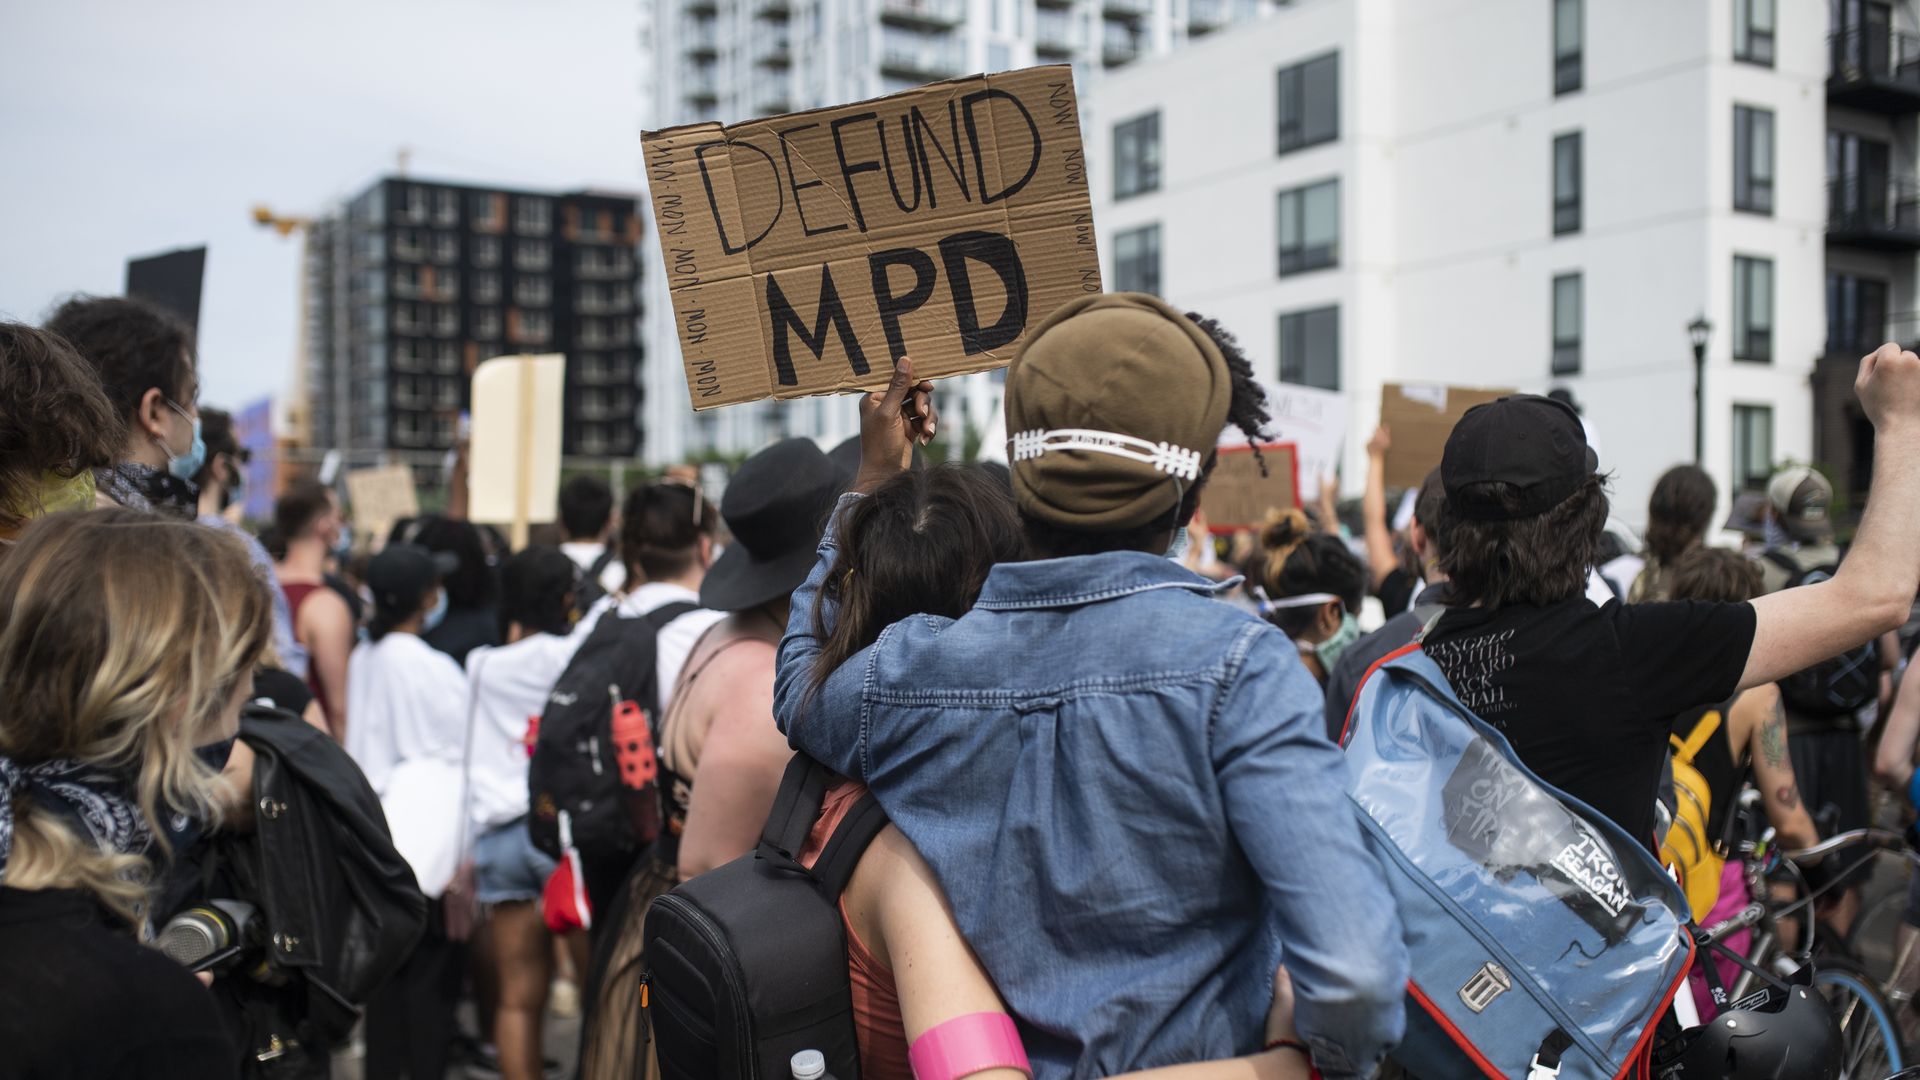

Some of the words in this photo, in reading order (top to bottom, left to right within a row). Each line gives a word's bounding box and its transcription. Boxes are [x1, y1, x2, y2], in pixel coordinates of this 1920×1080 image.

[694, 88, 1042, 255] DEFUND
[657, 195, 688, 236] NOW
[670, 249, 703, 292] NOW
[1079, 269, 1100, 293] NO
[681, 309, 709, 345] NOW
[766, 230, 1029, 387] MPD
[691, 360, 722, 397] NOW
[1424, 629, 1515, 657] D'ANGELO
[1446, 654, 1515, 680] GUARD
[1455, 672, 1494, 695] ACK
[1555, 843, 1630, 913] REAGAN
